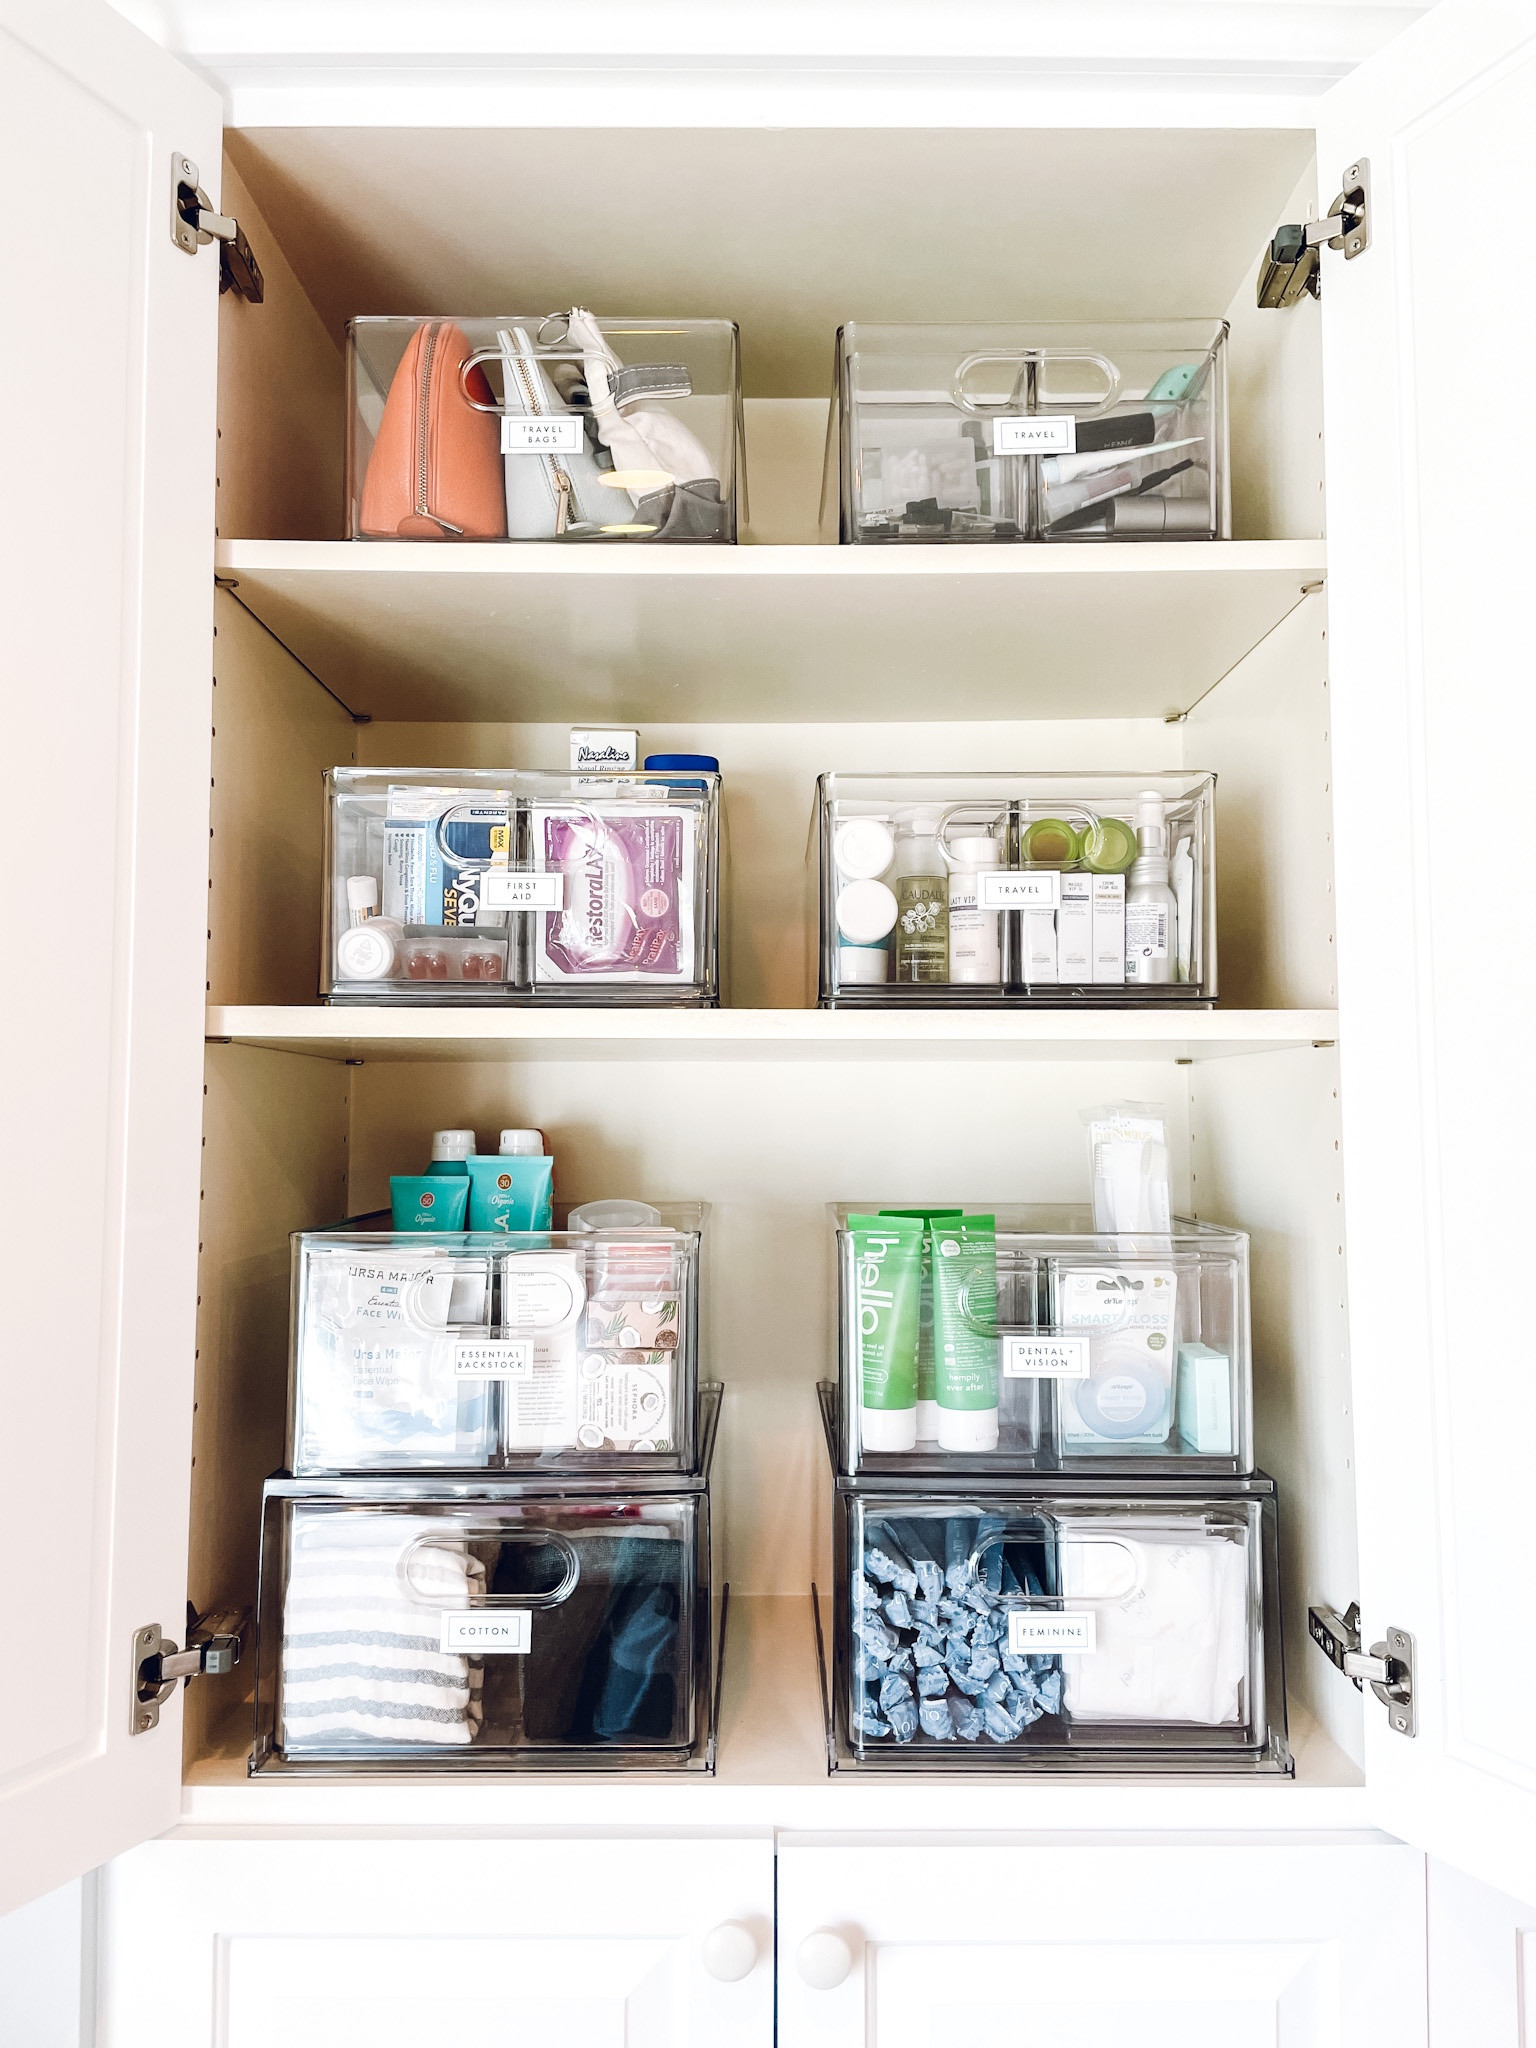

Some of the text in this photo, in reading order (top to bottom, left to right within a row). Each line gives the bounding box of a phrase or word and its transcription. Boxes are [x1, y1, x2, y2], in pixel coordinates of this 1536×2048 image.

[1014, 431, 1055, 439] TRAVEL
[578, 746, 629, 761] Nasaline
[497, 829, 505, 848] MAX
[429, 867, 437, 884] FLU
[507, 882, 537, 890] FIRST
[998, 886, 1040, 894] TRAVEL
[511, 892, 532, 900] AID
[963, 896, 976, 904] VIP
[444, 888, 457, 926] SEVE
[499, 1179, 510, 1188] 30
[422, 1197, 432, 1205] 50
[491, 1195, 515, 1208] Organic
[414, 1213, 436, 1226] Organic
[348, 1266, 384, 1280] URSA
[860, 1237, 900, 1336] hello
[356, 1306, 382, 1318] FACE
[1071, 1313, 1119, 1324] SMART
[461, 1351, 520, 1359] ESSENTIAL
[1018, 1347, 1064, 1355] DENTAL
[457, 1361, 523, 1369] BACKSTOCK
[949, 1373, 980, 1383] hempily
[946, 1382, 984, 1392] ever after
[459, 1627, 509, 1635] COTTON
[1022, 1628, 1083, 1636] FEMININE
